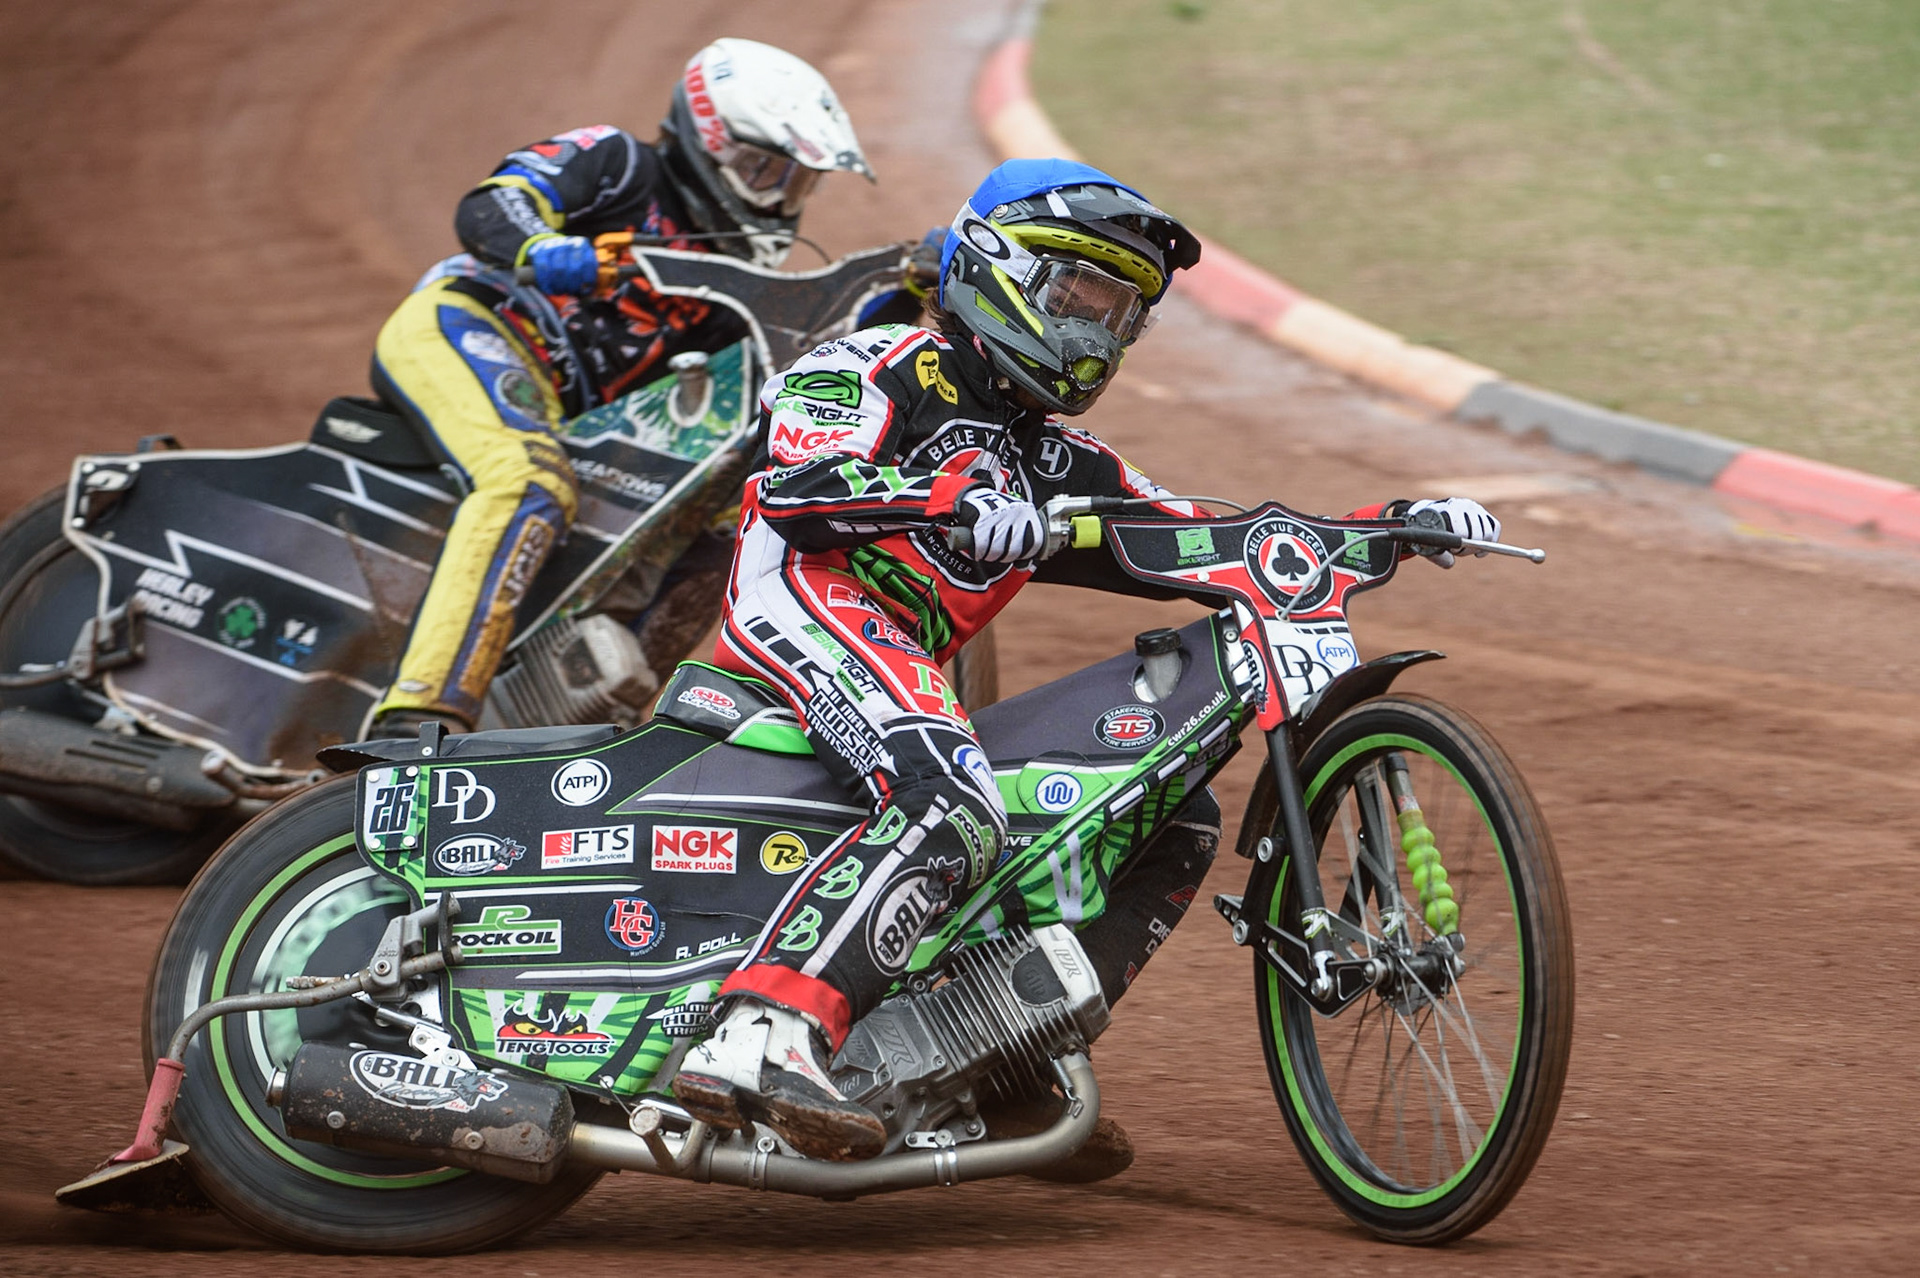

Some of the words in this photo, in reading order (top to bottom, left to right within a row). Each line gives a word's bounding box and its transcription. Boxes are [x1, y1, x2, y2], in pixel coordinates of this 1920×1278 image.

[685, 63, 727, 152] 100%
[1022, 259, 1043, 288] OAKLEY
[773, 421, 854, 450] NGK
[922, 528, 973, 575] ANCHESTER
[1248, 526, 1270, 556] BELLE
[1270, 522, 1294, 534] VUE
[1298, 530, 1326, 557] ACES
[1323, 646, 1351, 659] ATPI
[1104, 706, 1155, 721] STAKEFORD
[1106, 719, 1151, 734] STS
[1166, 690, 1227, 747] cwr26.co.uk
[1102, 736, 1120, 747] TYRE
[1120, 734, 1158, 748] SERVICES
[562, 775, 599, 790] ATPI
[368, 781, 417, 836] 26
[445, 844, 497, 864] BALL
[573, 827, 630, 854] FTS
[654, 829, 735, 860] NGK
[593, 853, 627, 861] Services
[655, 860, 692, 870] SPARK
[694, 861, 734, 871] PLUGS
[609, 899, 654, 948] HG
[515, 931, 556, 945] OIL
[698, 932, 742, 955] POLL
[370, 1056, 460, 1089] BALL
